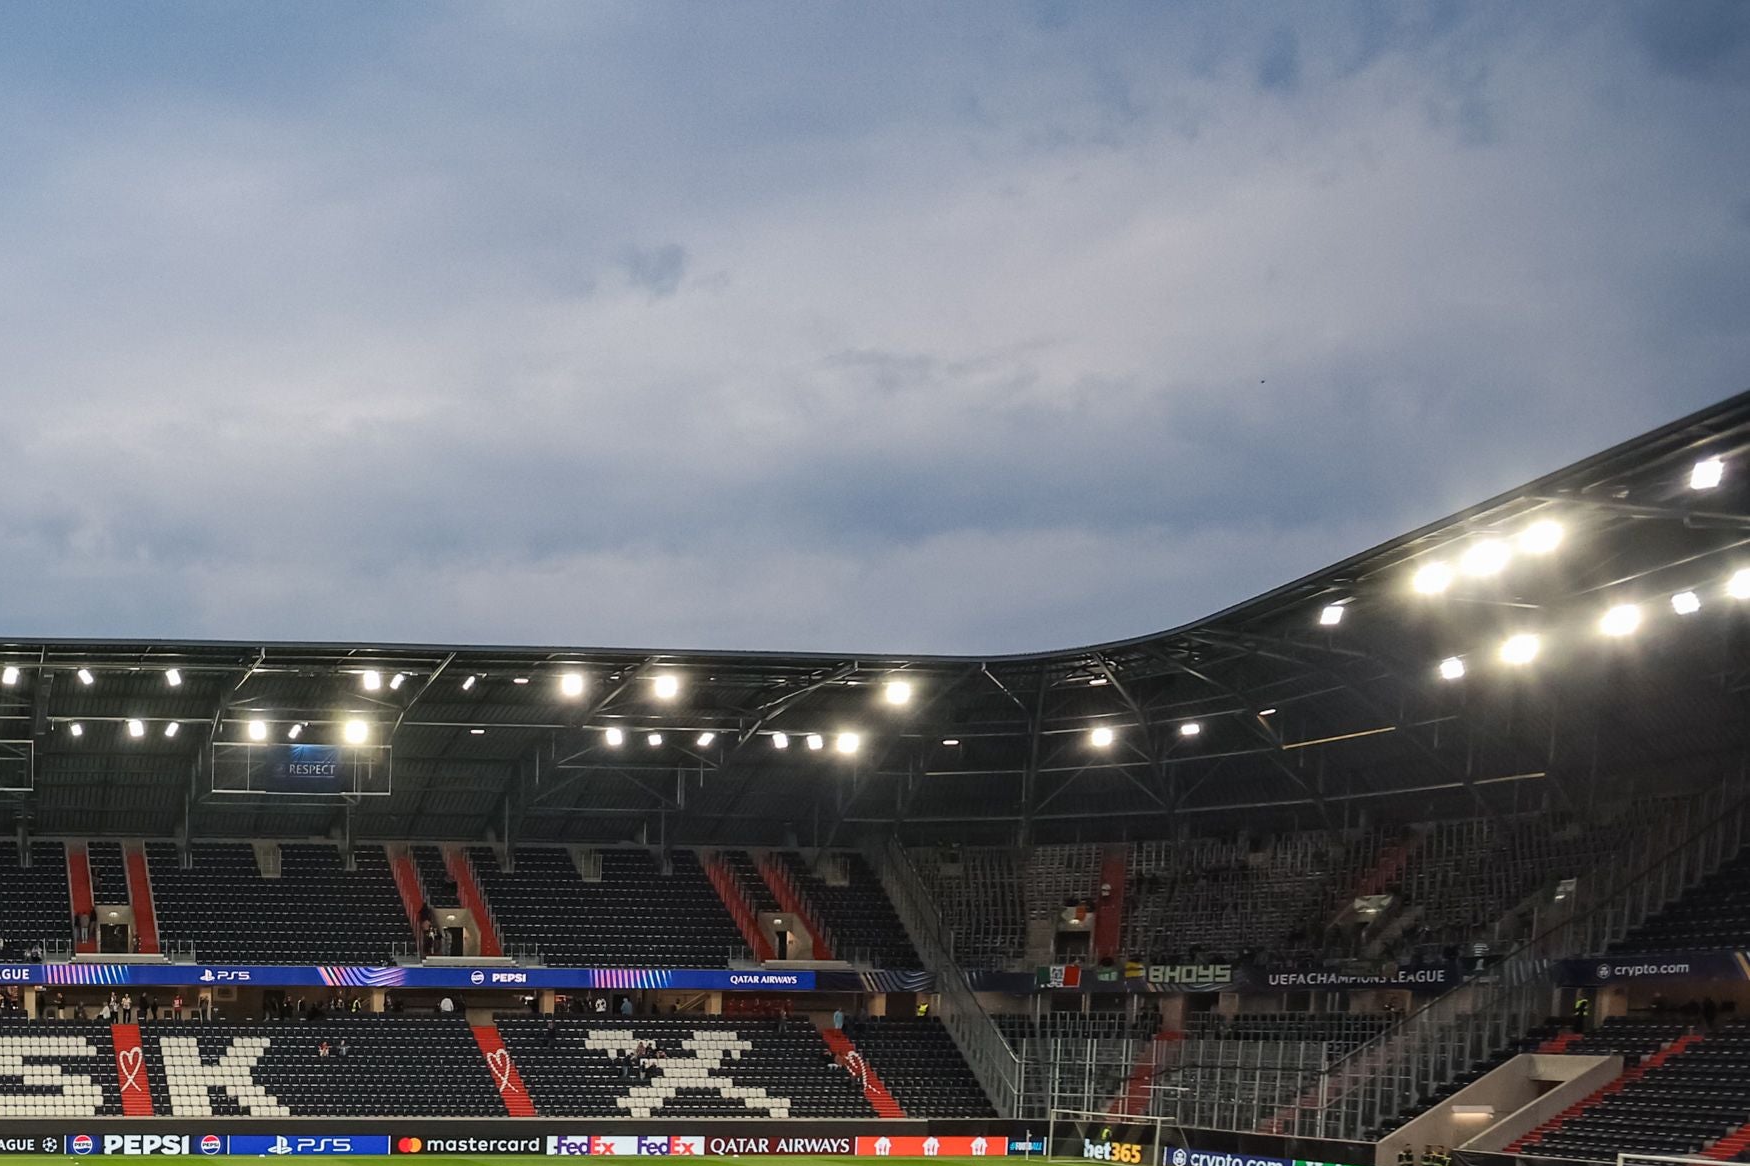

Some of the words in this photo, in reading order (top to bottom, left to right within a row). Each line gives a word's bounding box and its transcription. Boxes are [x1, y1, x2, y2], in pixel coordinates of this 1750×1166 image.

[289, 764, 336, 775] RESPECT
[216, 970, 250, 980] PS5
[1149, 964, 1232, 983] BHOYS
[1614, 963, 1689, 977] crypto.com
[492, 973, 527, 983] PEPSI
[730, 975, 760, 985] QATAR
[761, 975, 797, 985] AIRWAYS
[1268, 973, 1305, 985] UEFA
[103, 1135, 190, 1155] PEPSI
[297, 1138, 352, 1152] PS5
[427, 1137, 540, 1152] mastercard
[557, 1136, 615, 1155] FedEx
[637, 1136, 695, 1155] FedEx
[710, 1138, 769, 1155] QATAR
[776, 1138, 850, 1153] AIRWAYS
[1083, 1138, 1142, 1164] bet365
